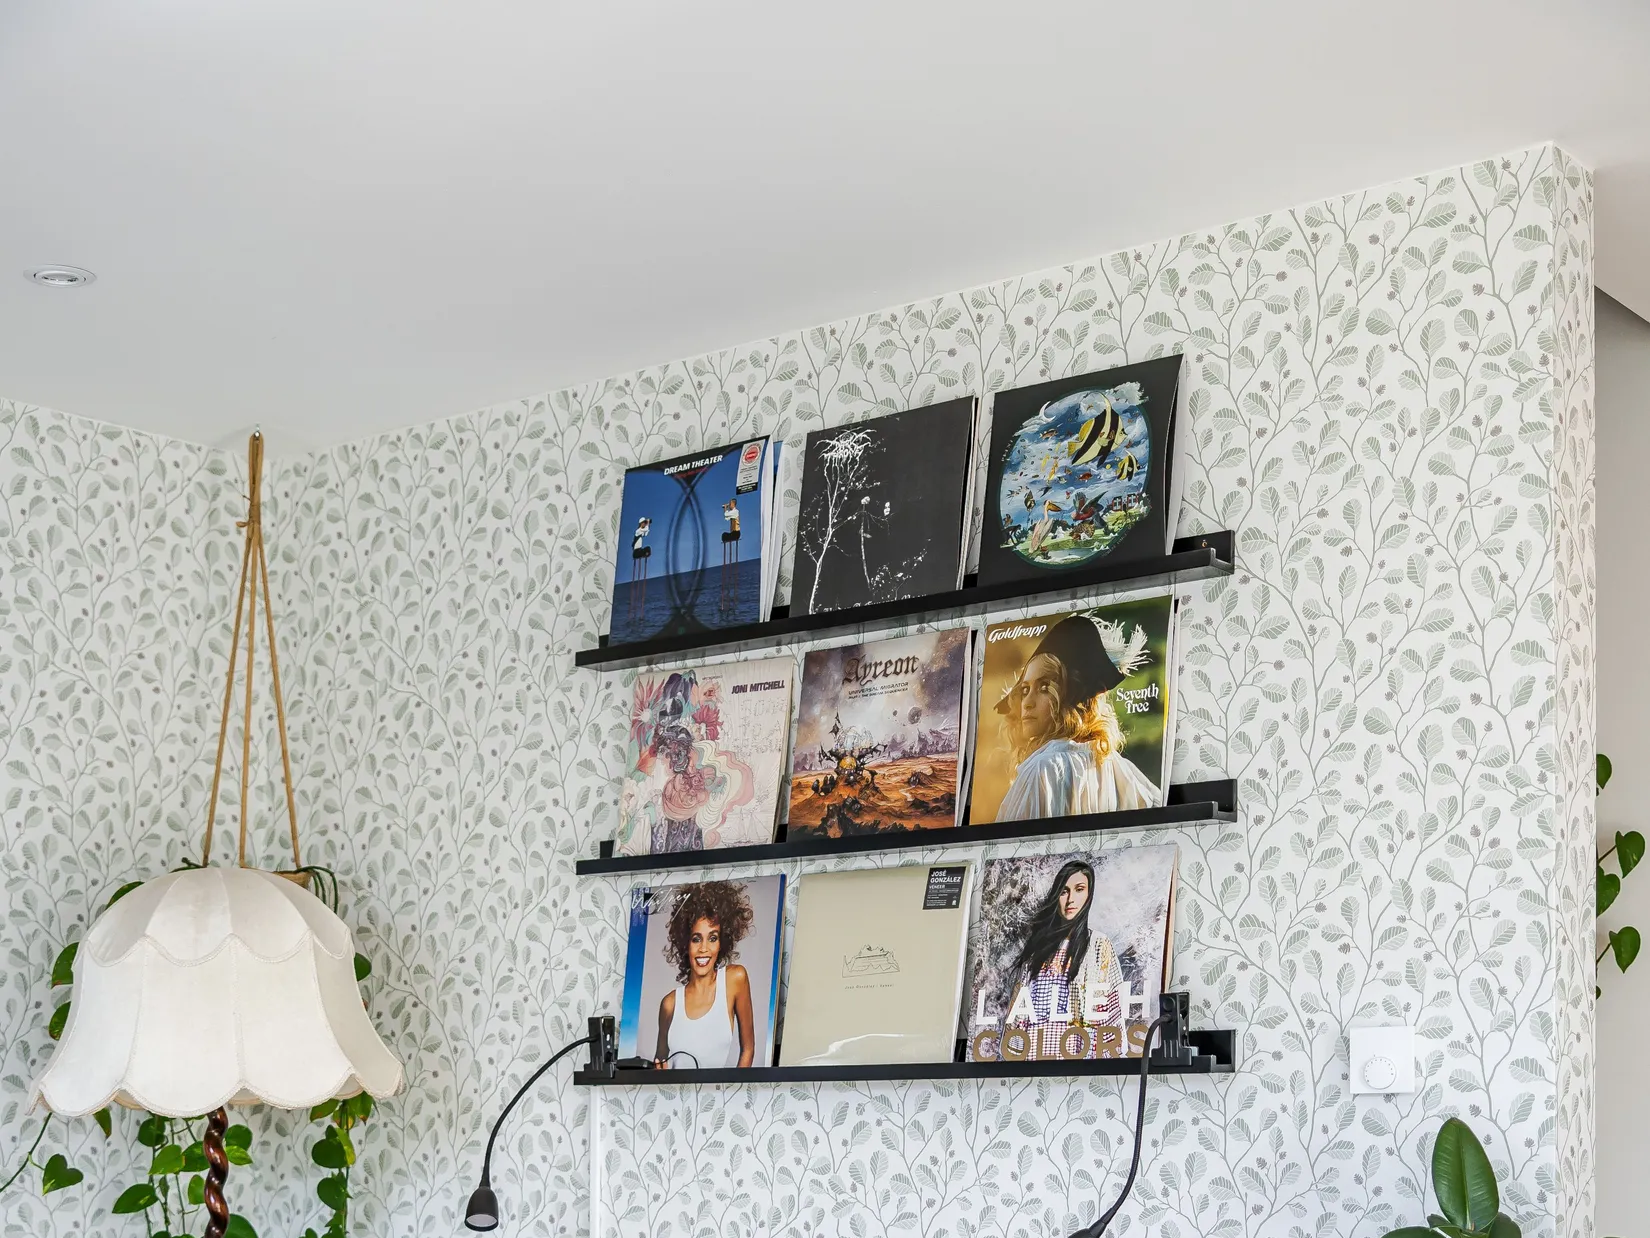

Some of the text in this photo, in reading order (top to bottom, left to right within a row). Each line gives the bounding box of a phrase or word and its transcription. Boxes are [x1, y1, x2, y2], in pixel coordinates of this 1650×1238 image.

[664, 462, 690, 475] DREAM
[691, 455, 723, 469] THEATER
[988, 624, 1047, 643] Goldfrapp
[842, 653, 920, 686] Ayreon
[731, 680, 785, 695] JONI MITCHELL
[1115, 683, 1159, 702] Seventh
[1124, 700, 1150, 715] Tree
[631, 887, 692, 929] Whitney
[975, 980, 1152, 1025] LALEH
[973, 1024, 1150, 1062] COLORS
